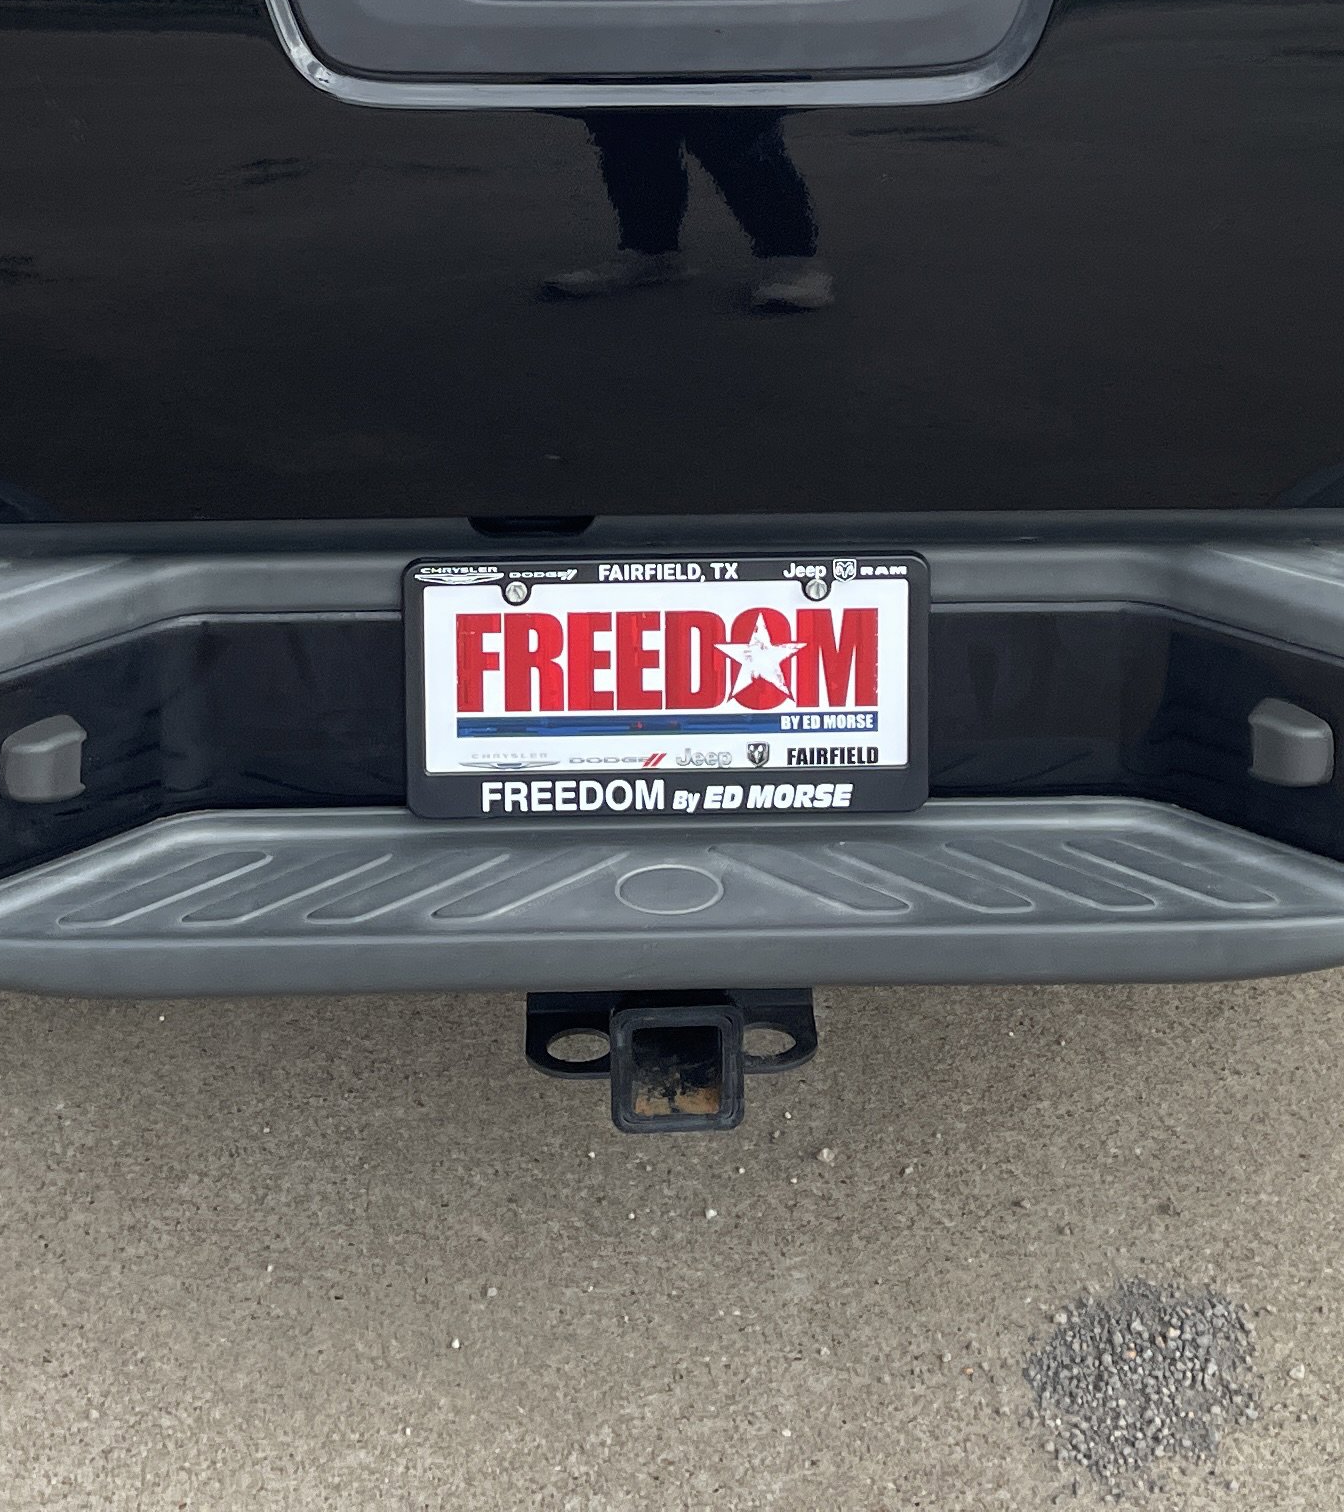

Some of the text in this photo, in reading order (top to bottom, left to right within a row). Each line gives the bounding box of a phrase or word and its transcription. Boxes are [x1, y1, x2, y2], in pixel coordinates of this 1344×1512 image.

[598, 562, 739, 583] FAIRFIELD, TX
[783, 562, 827, 579] Jeep
[860, 566, 907, 576] RAM
[456, 607, 879, 713] FREEDOM
[780, 714, 874, 730] BY ED MORSE
[675, 747, 732, 768] Jeep
[786, 746, 879, 766] FAIRFIELD
[481, 779, 854, 813] FREEDOM By ED MORSE
